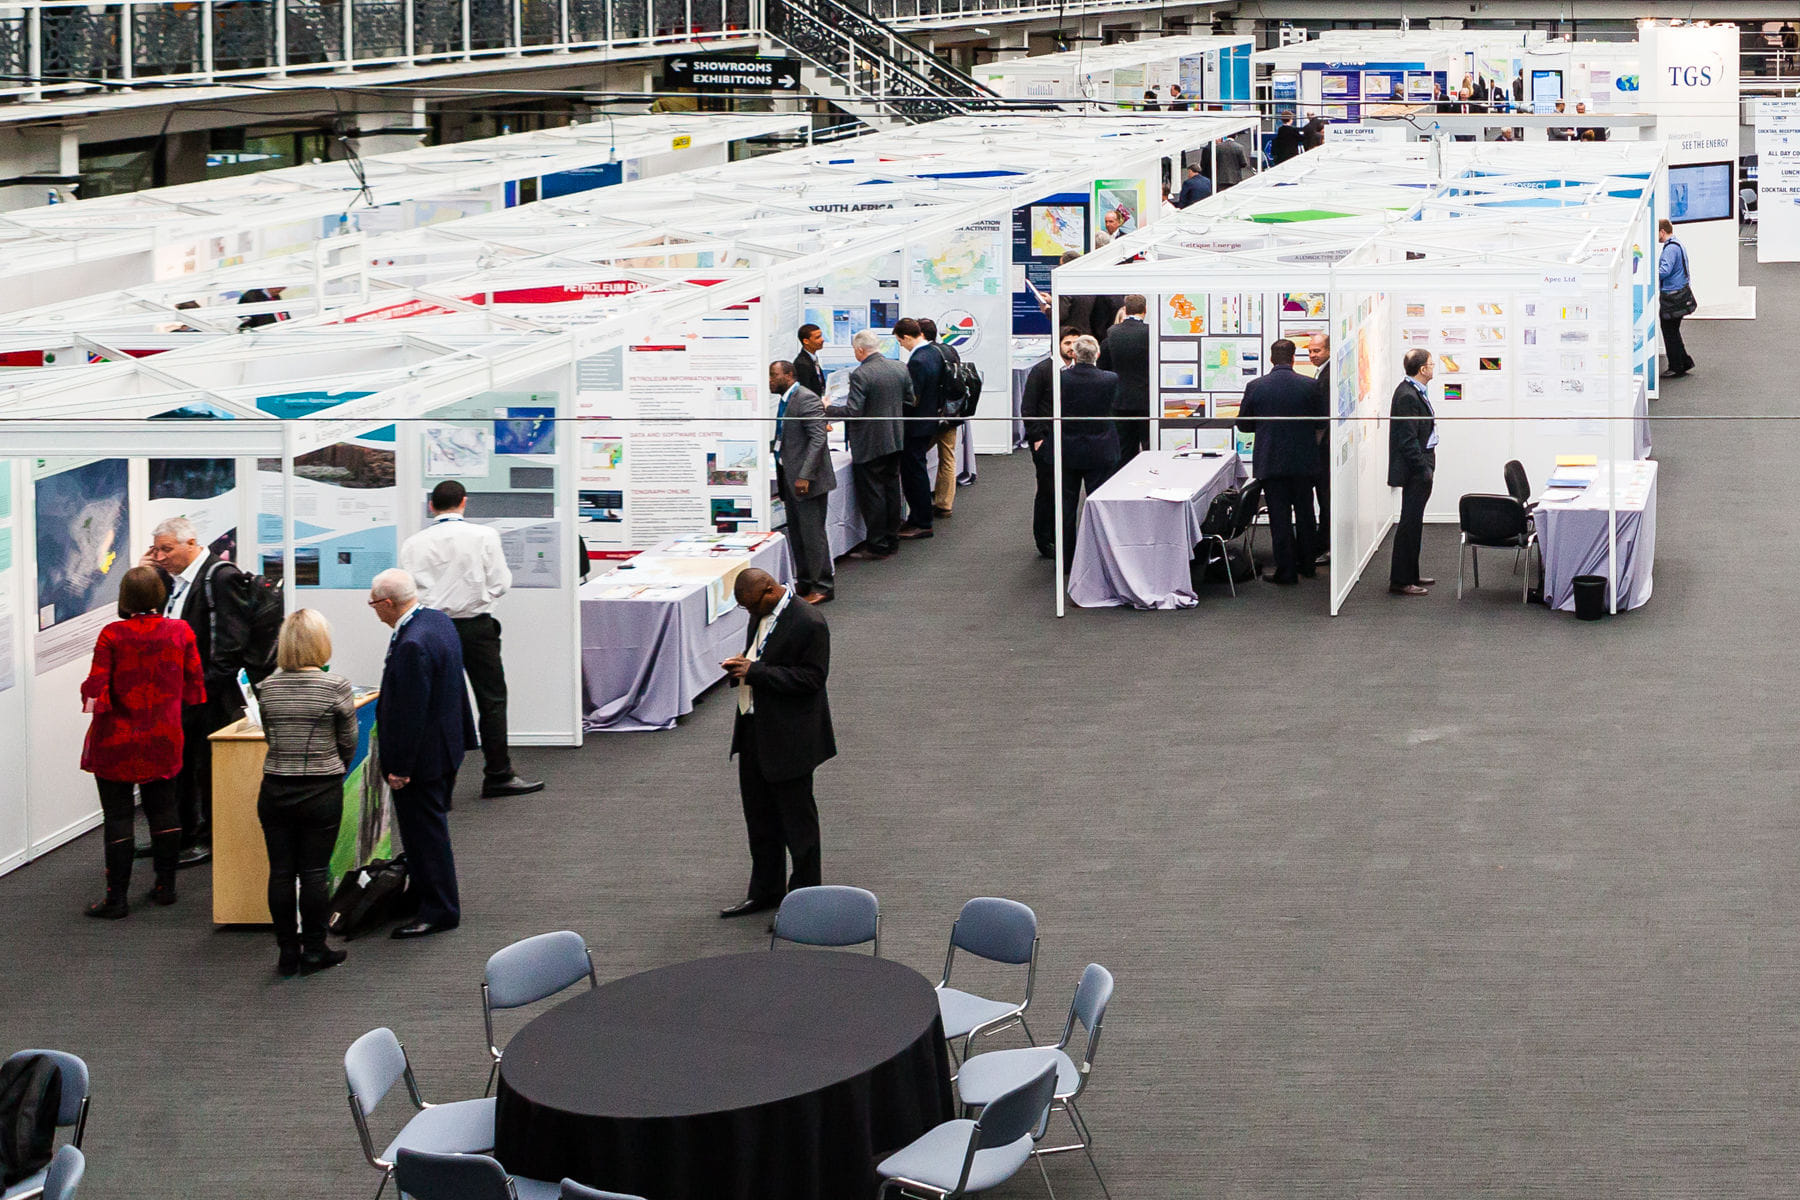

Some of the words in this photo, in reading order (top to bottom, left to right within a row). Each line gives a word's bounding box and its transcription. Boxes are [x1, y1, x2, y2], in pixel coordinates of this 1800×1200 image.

[692, 61, 773, 73] SHOWROOMS
[692, 74, 773, 86] EXHIBITIONS
[1668, 65, 1712, 87] TGS
[1681, 140, 1693, 150] SEE
[1693, 139, 1705, 150] THE
[1705, 138, 1729, 149] ENERGY
[563, 282, 626, 293] PETROLEUM
